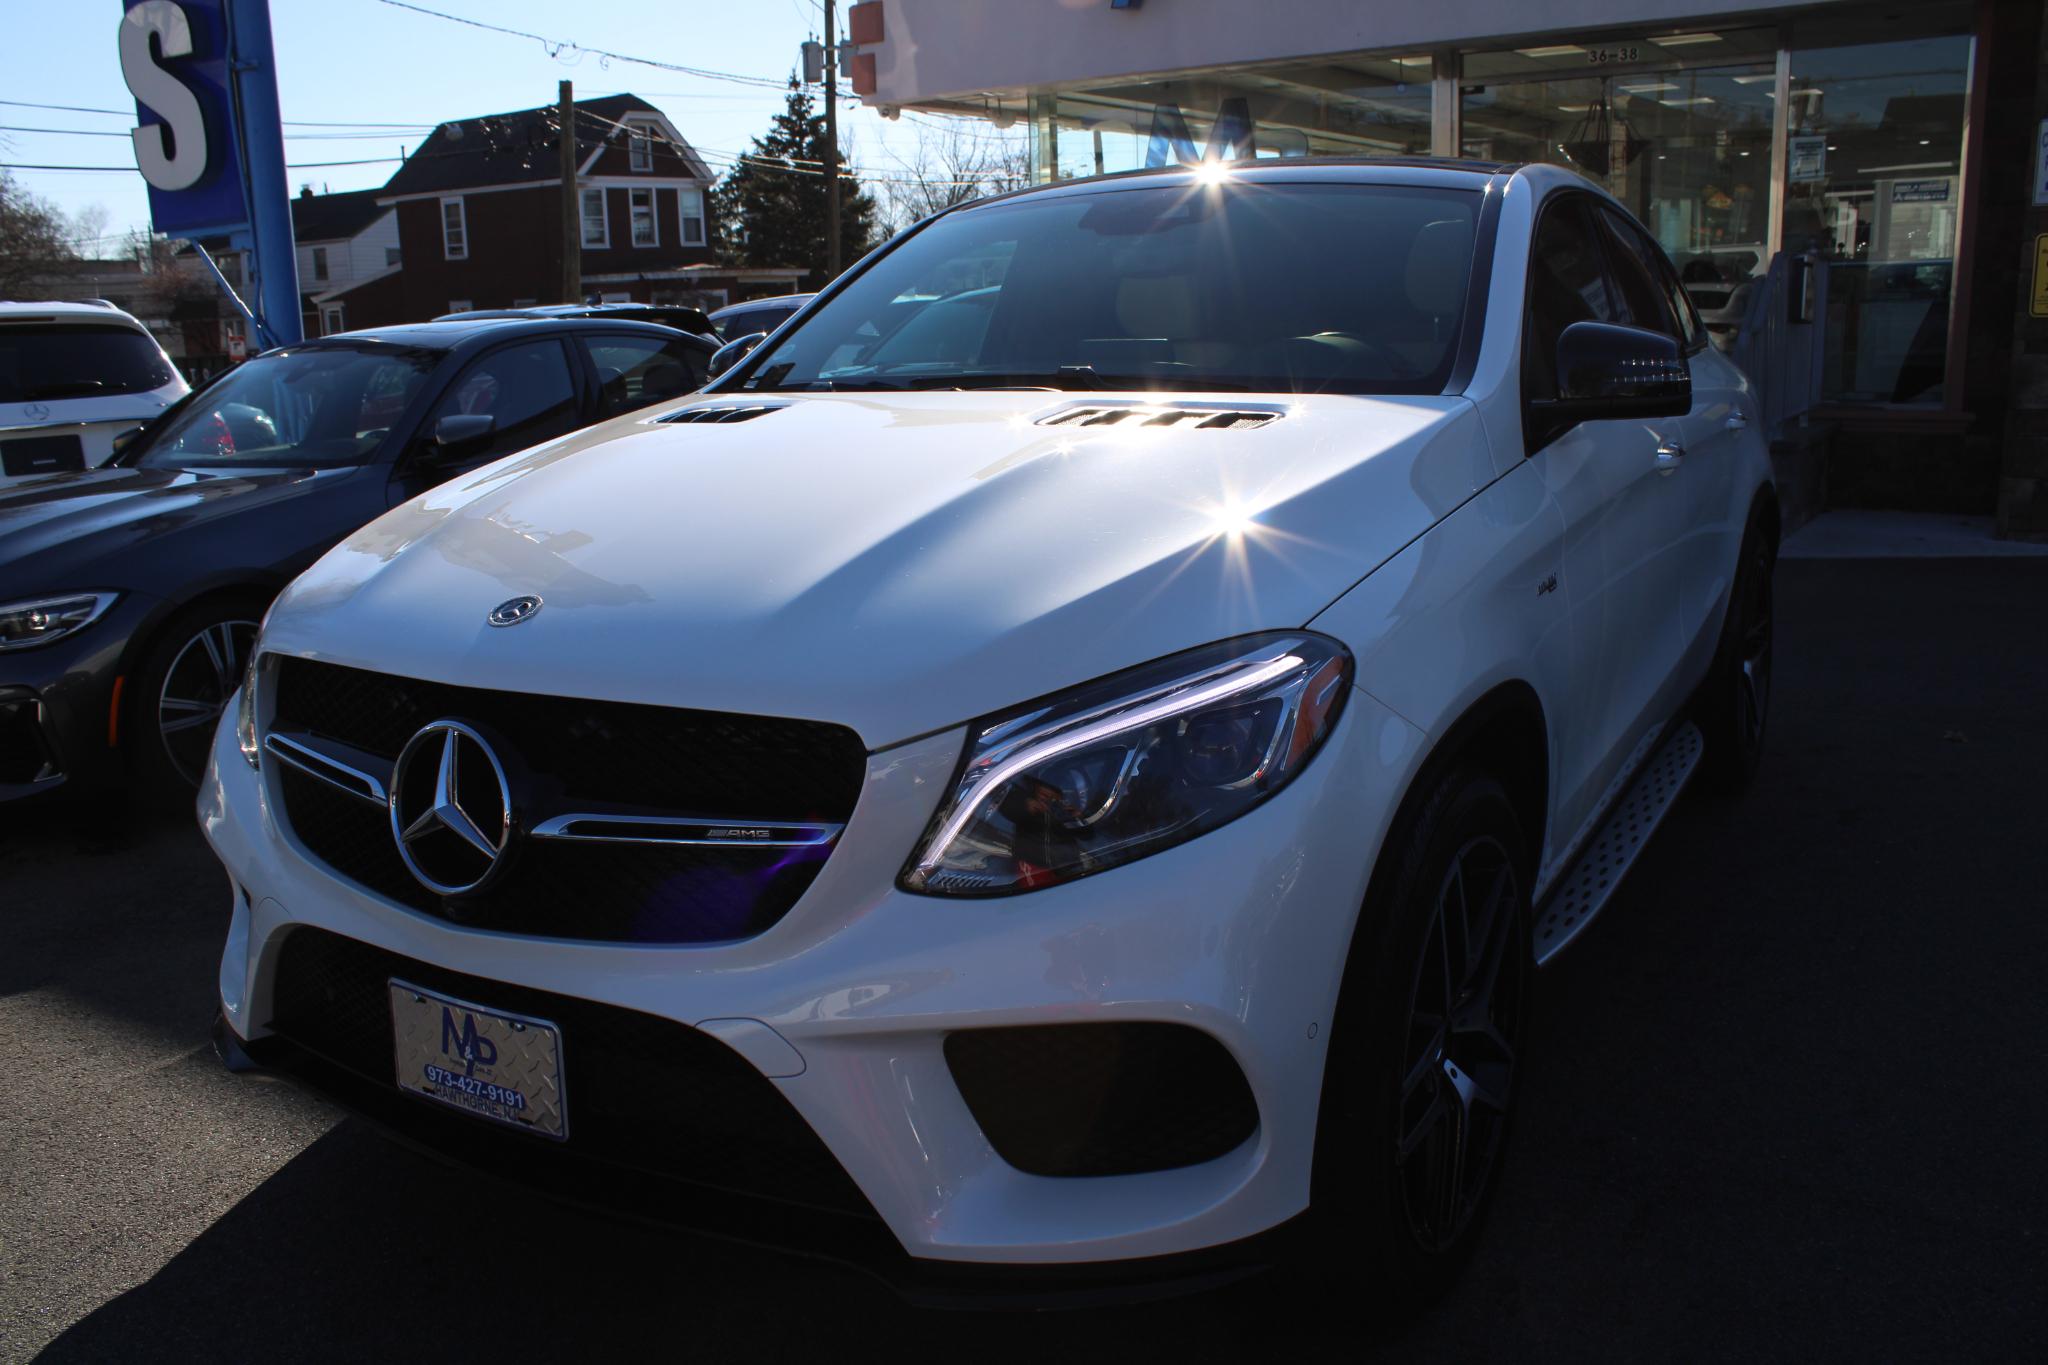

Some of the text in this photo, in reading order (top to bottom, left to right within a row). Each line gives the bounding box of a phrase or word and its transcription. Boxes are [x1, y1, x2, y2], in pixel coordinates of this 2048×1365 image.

[1589, 47, 1638, 62] 36-38
[119, 0, 208, 191] S
[427, 1066, 524, 1110] 973-427-9191
